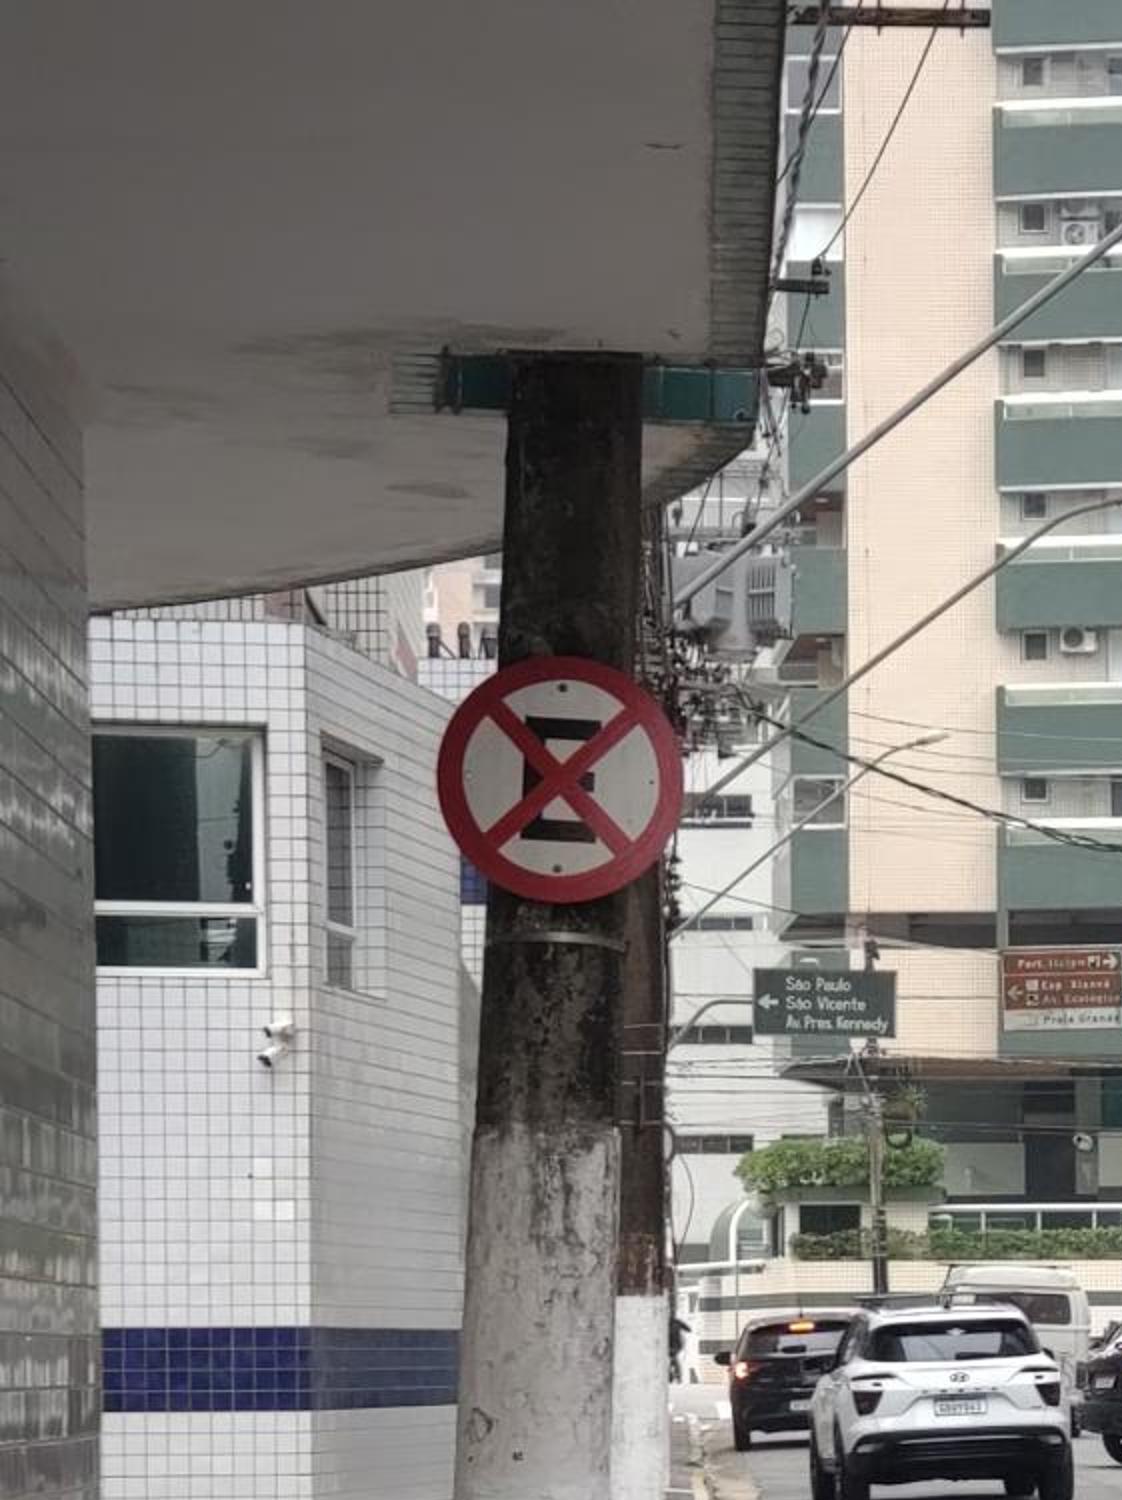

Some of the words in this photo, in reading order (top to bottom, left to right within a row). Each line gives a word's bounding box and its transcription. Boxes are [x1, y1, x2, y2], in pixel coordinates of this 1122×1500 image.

[816, 976, 852, 992] Paulo
[817, 996, 867, 1011] Vicente
[836, 1015, 888, 1034] Kennedy
